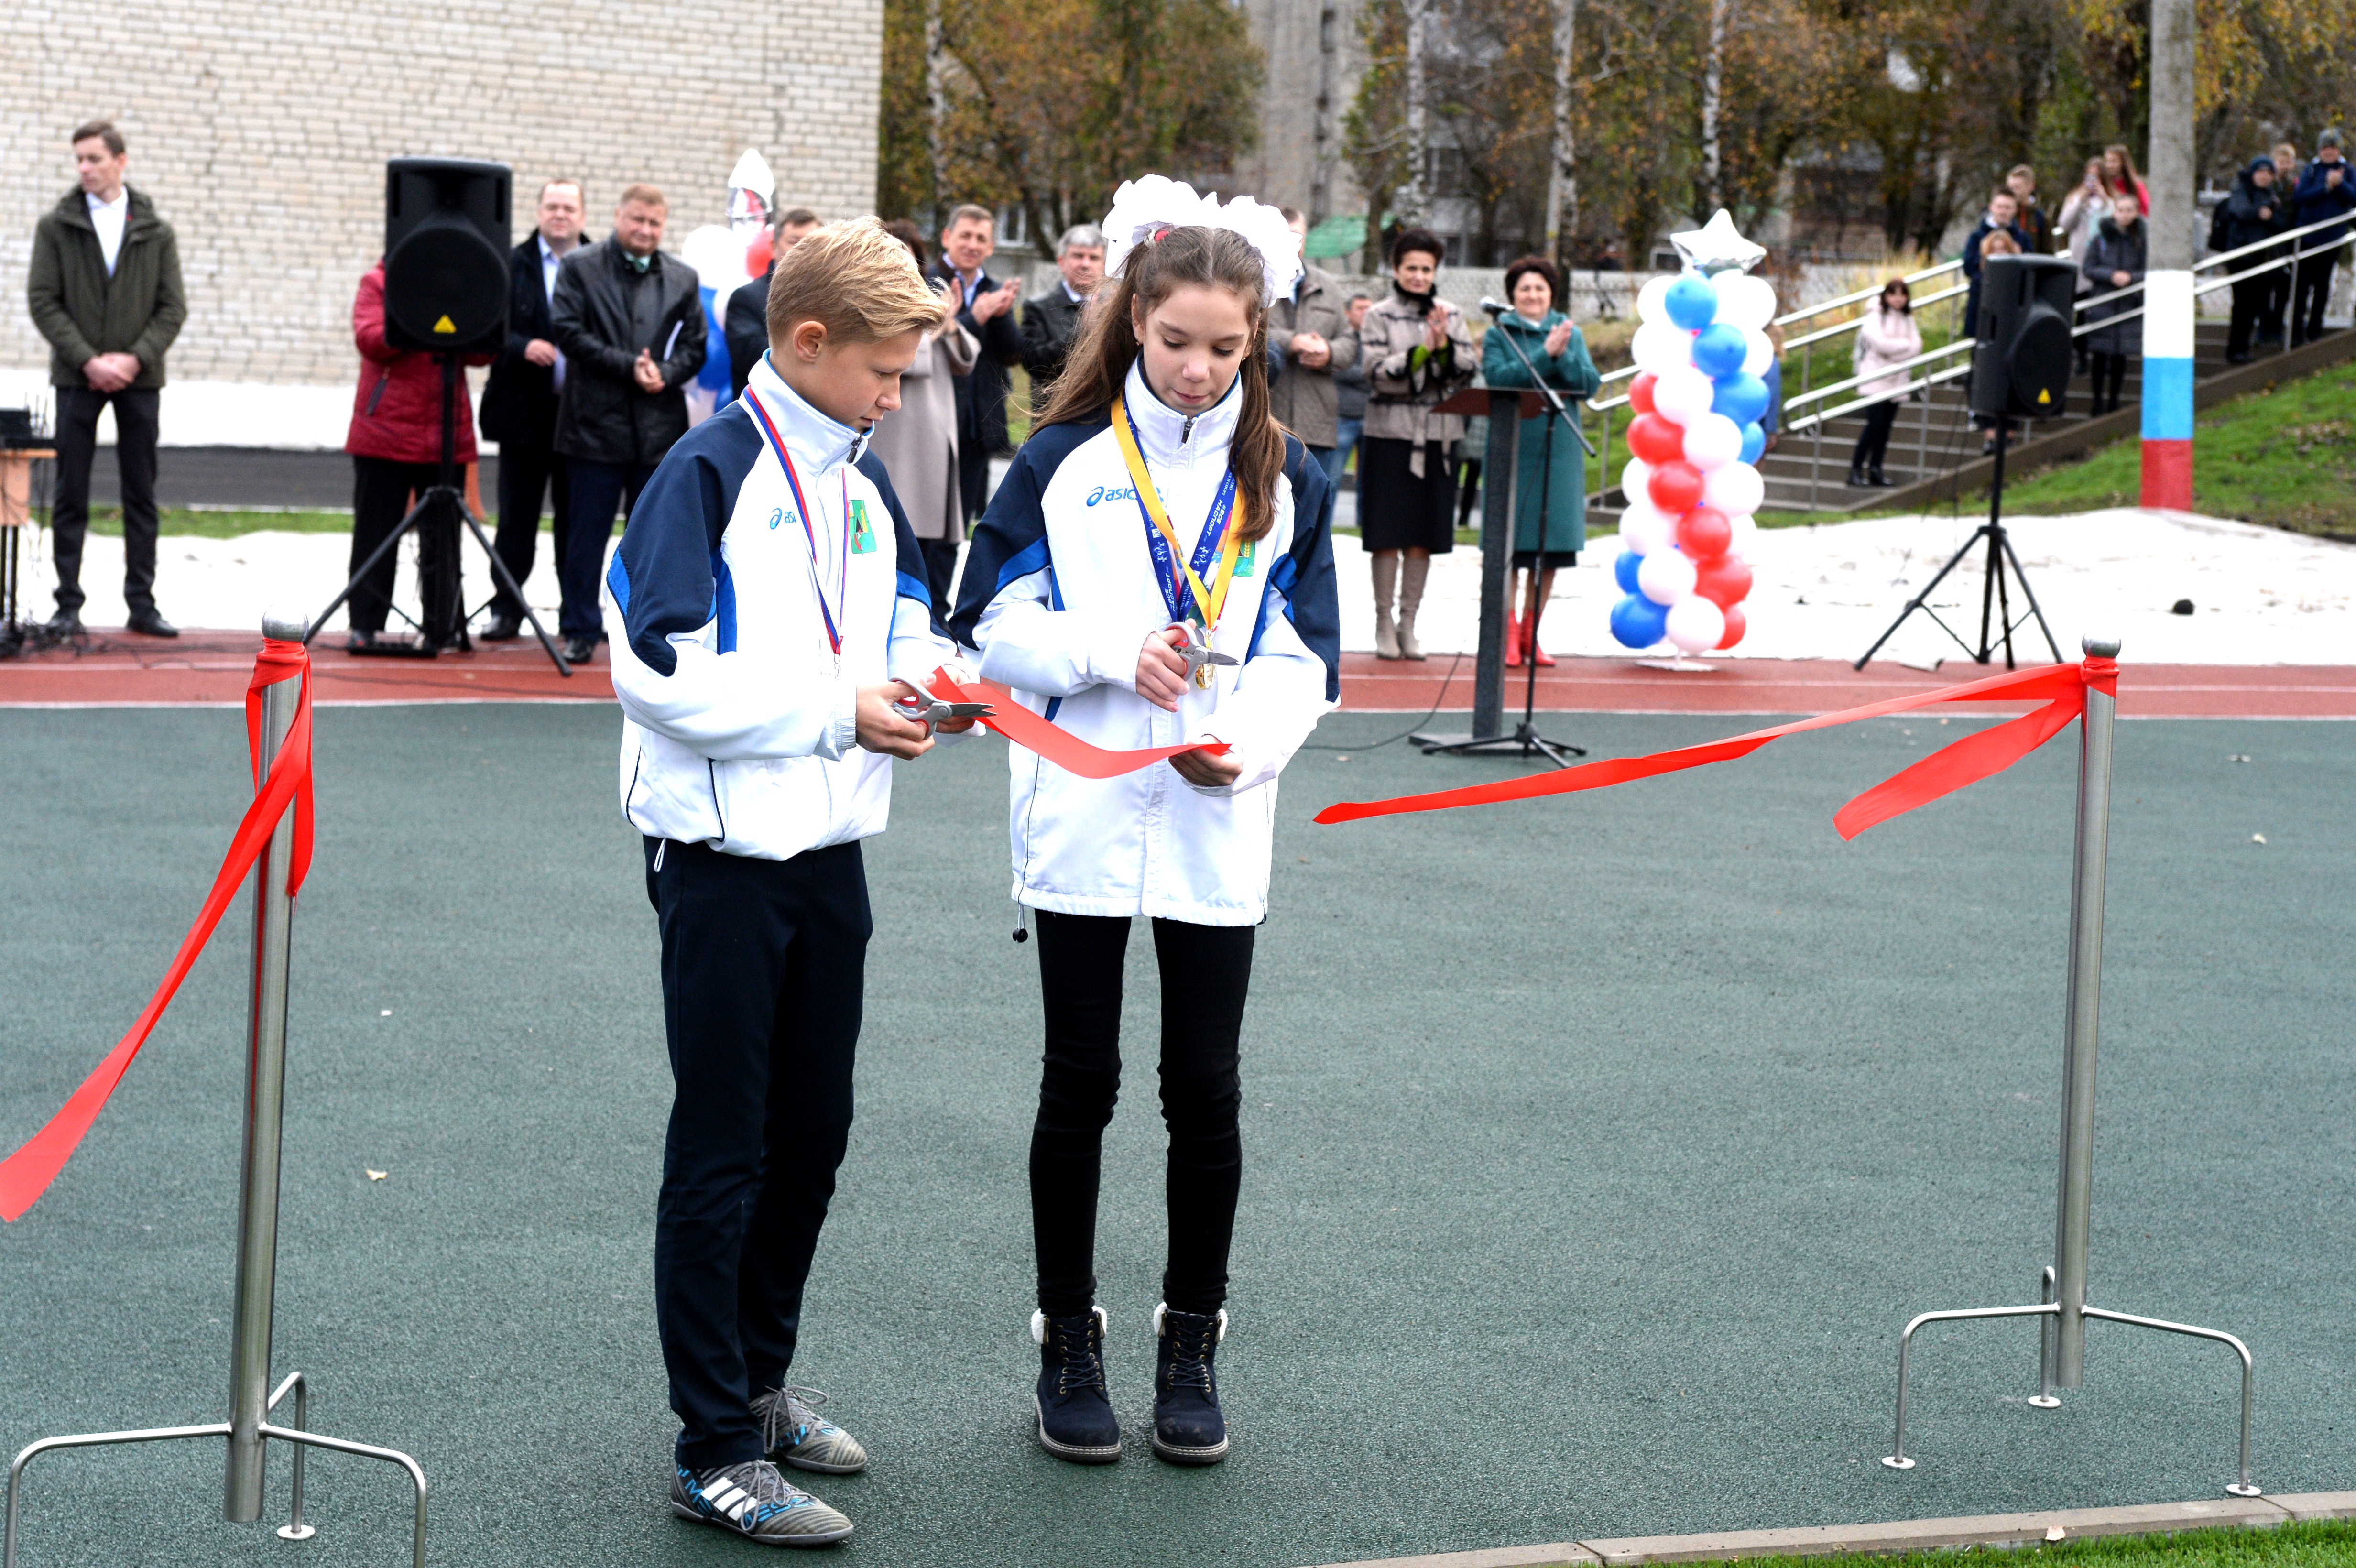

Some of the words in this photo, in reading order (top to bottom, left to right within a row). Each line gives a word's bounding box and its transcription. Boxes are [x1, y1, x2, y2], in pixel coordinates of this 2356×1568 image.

[1105, 488, 1138, 501] asic
[1206, 499, 1223, 537] НАСПОРТ
[1216, 504, 1226, 525] #ВСЕ
